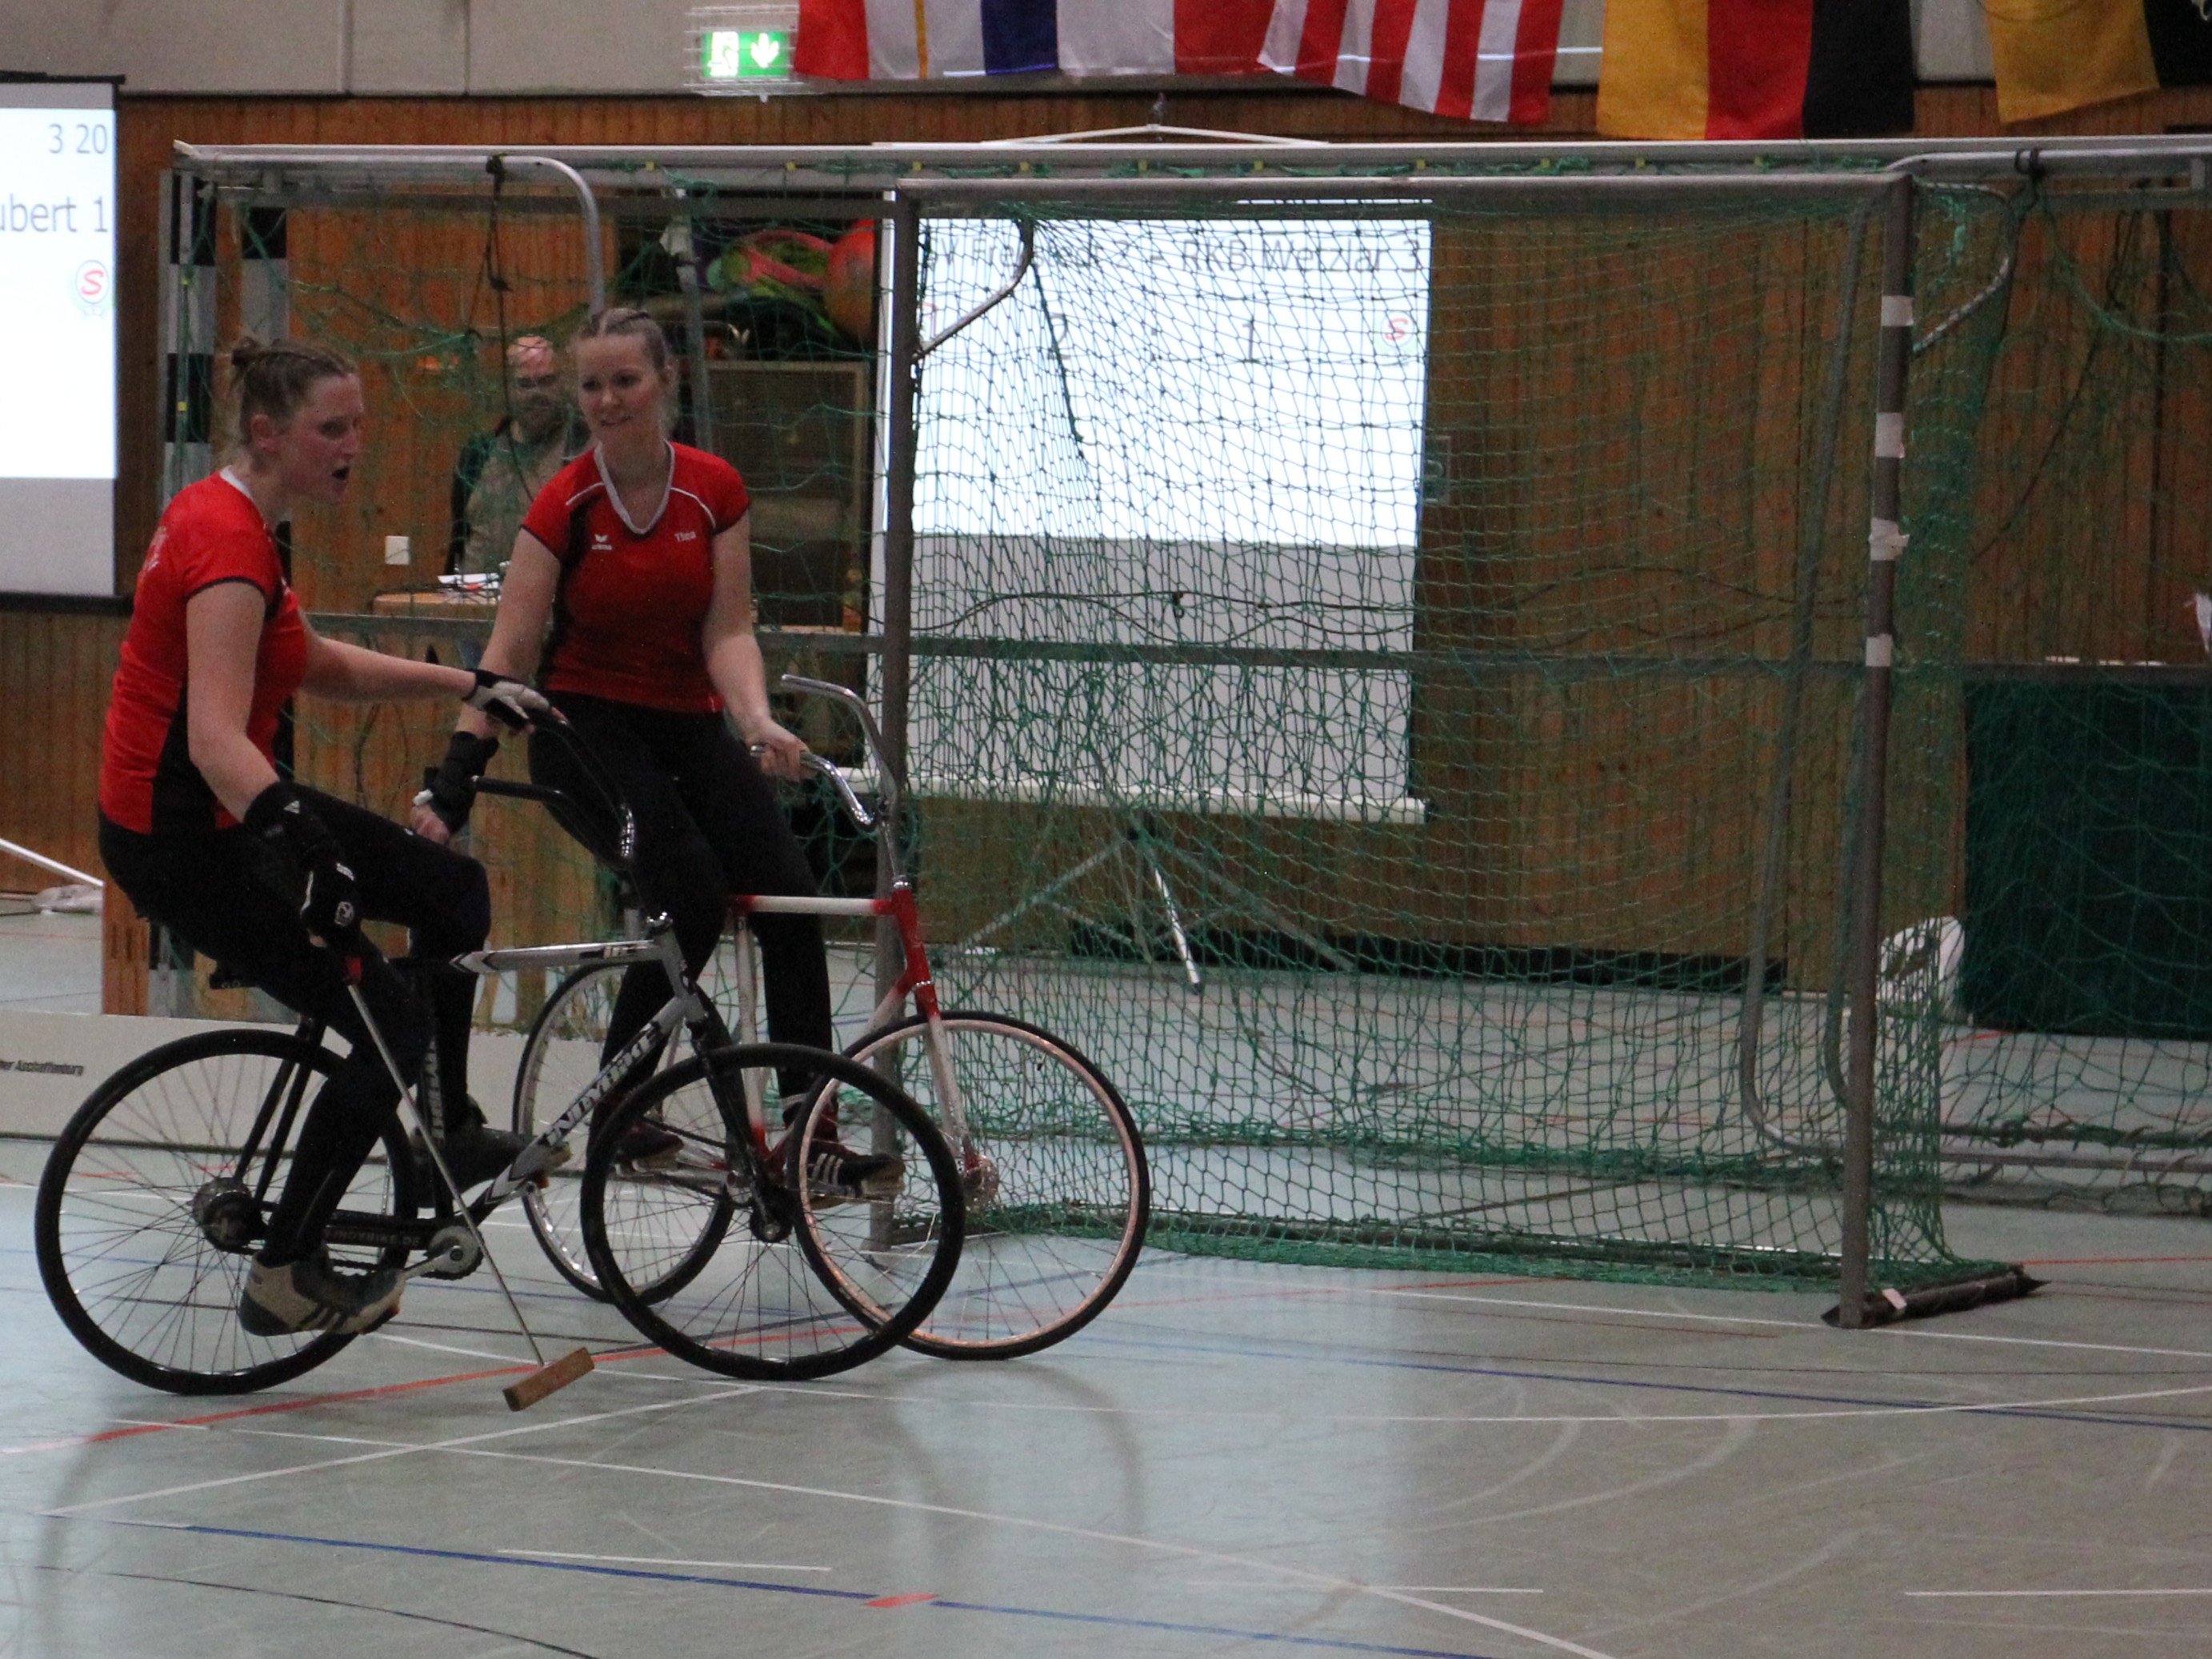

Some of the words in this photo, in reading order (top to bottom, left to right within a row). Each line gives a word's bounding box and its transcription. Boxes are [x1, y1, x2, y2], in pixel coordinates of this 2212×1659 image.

[49, 123, 63, 154] 3
[76, 123, 108, 154] 20
[94, 195, 108, 233] 1
[1183, 239, 1246, 272] RKB
